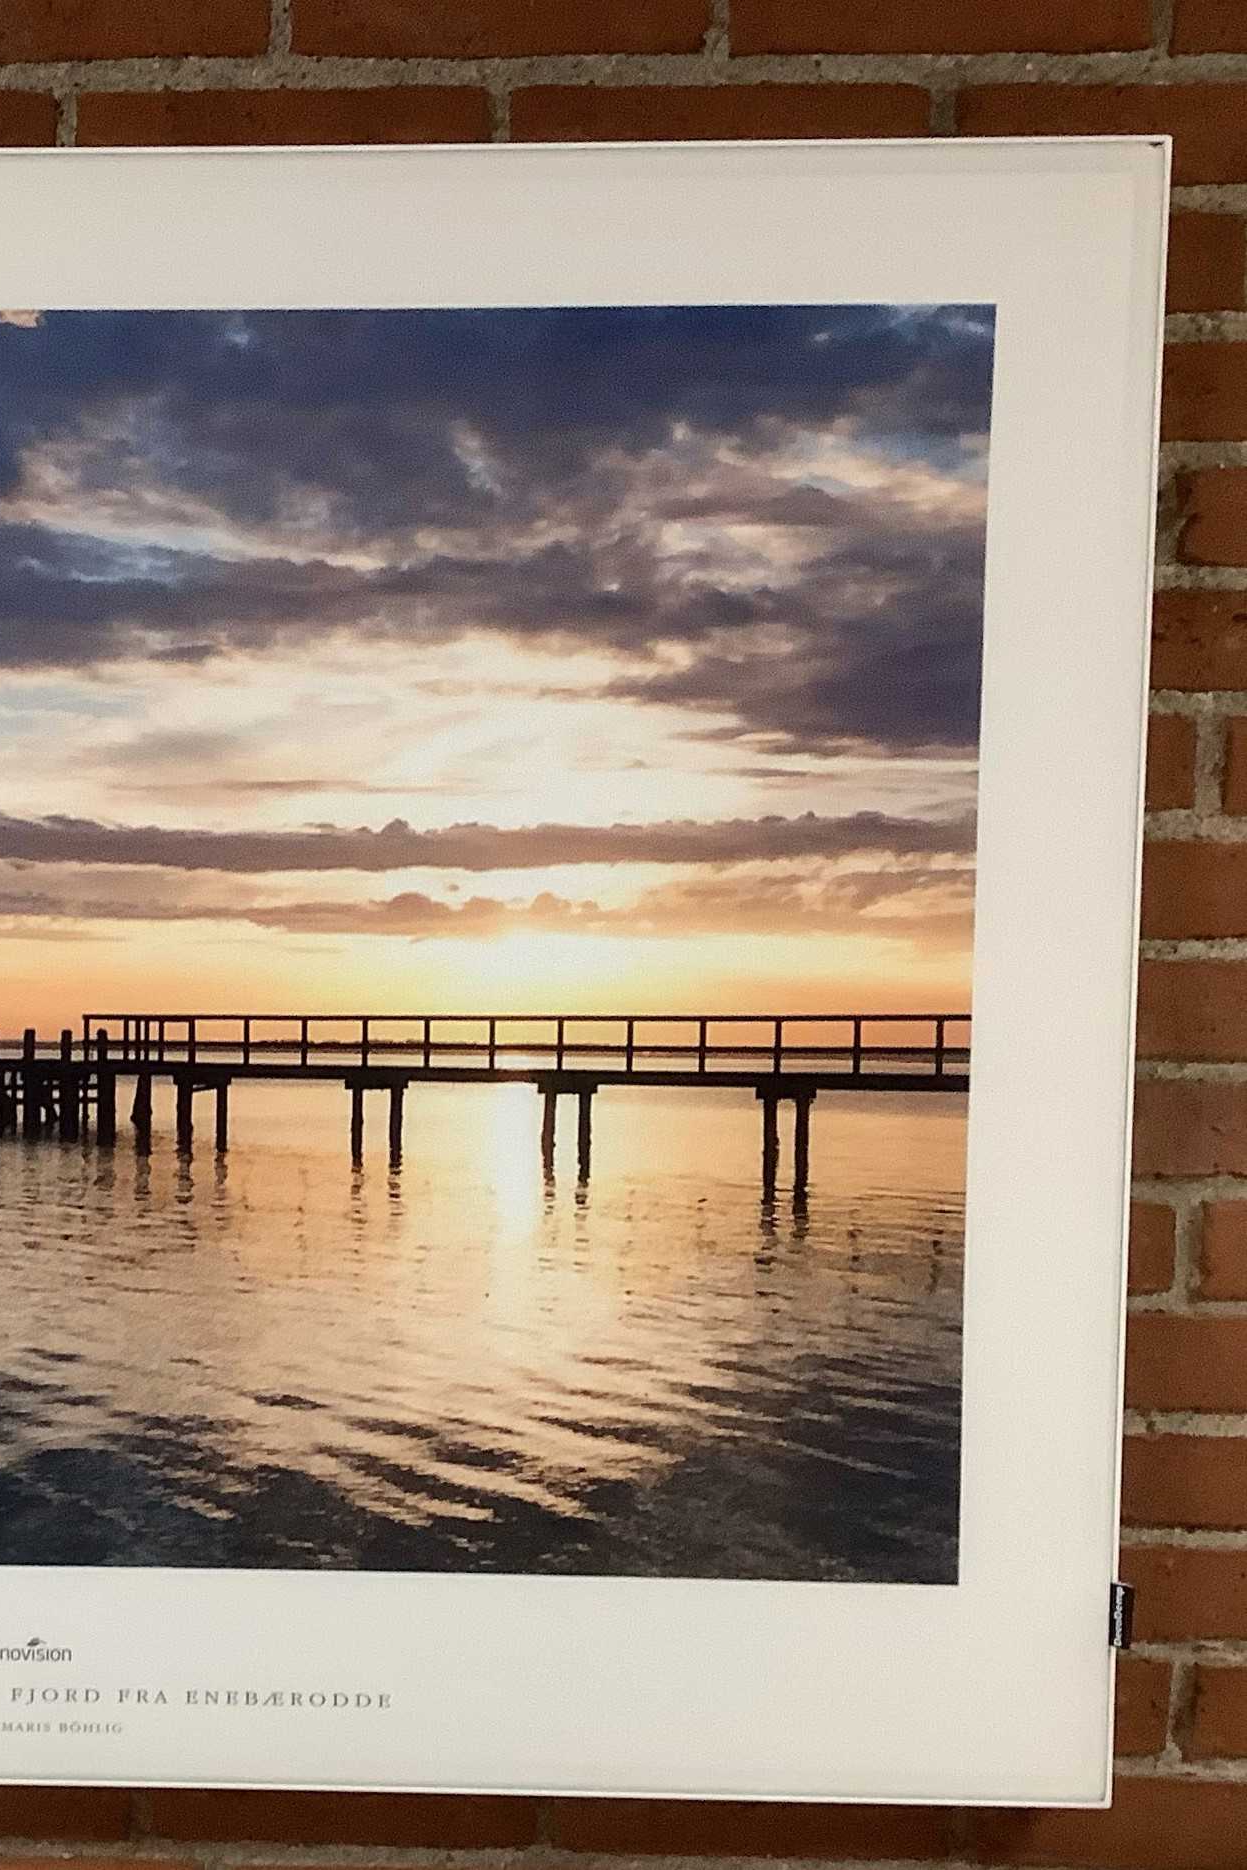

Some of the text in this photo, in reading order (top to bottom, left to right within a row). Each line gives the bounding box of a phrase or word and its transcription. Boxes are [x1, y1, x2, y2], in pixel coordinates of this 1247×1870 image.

[11, 1687, 100, 1705] FJORD
[118, 1689, 168, 1705] FRA
[185, 1689, 392, 1709] ENEBÆRODDE
